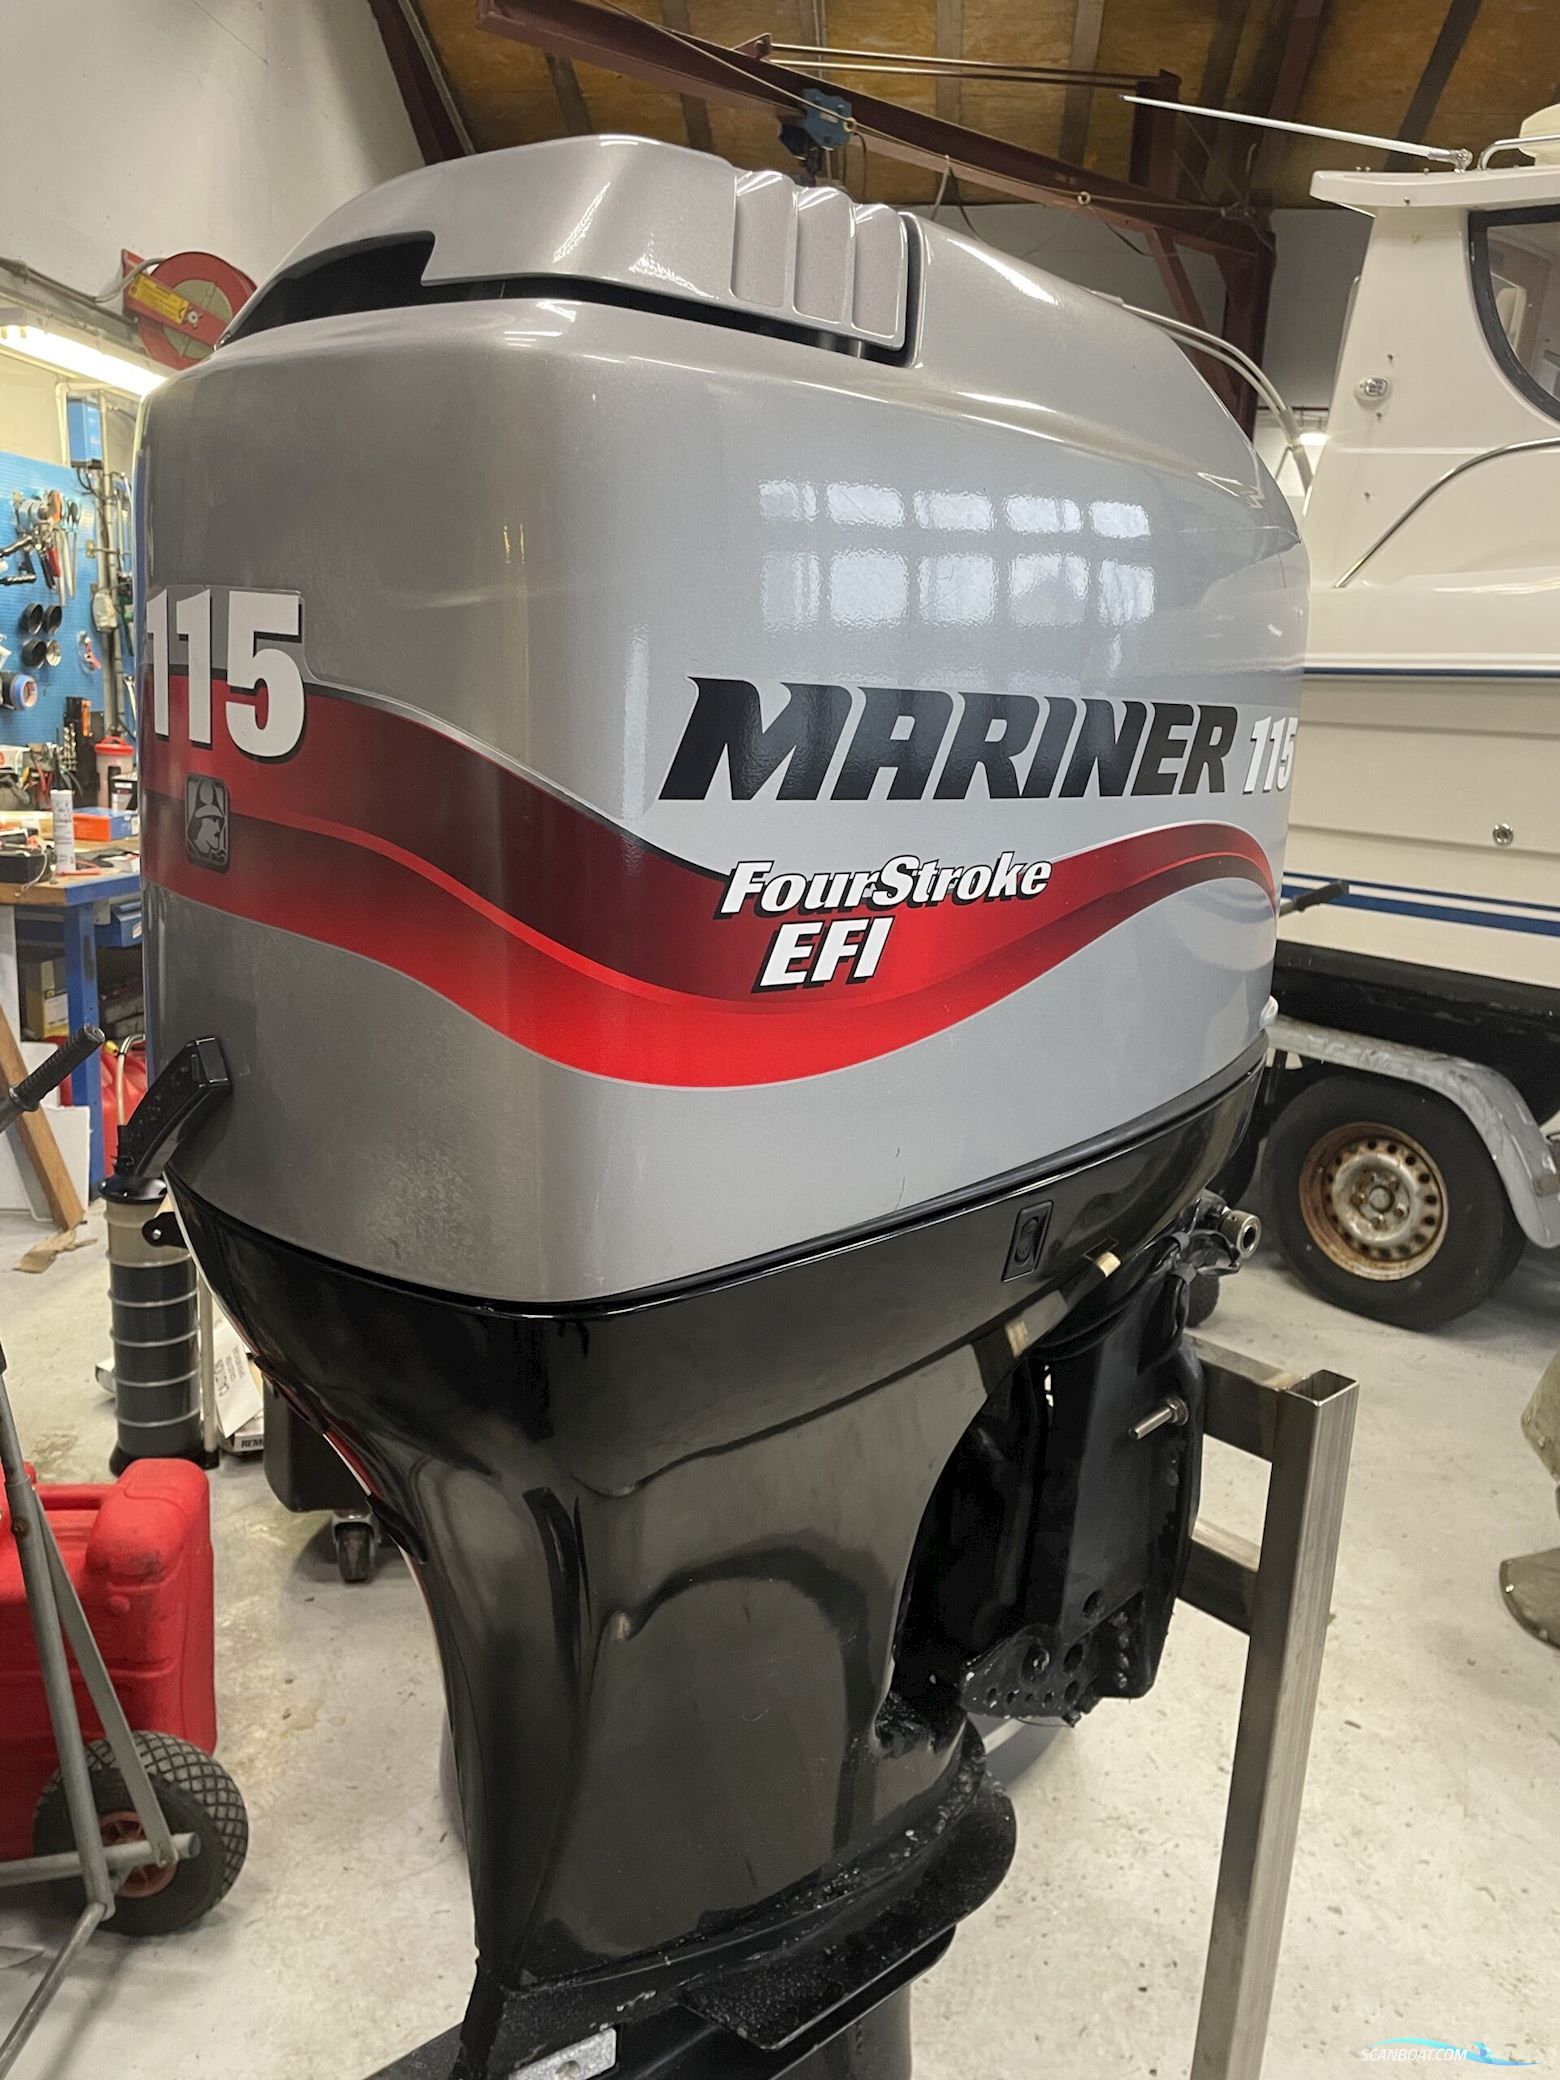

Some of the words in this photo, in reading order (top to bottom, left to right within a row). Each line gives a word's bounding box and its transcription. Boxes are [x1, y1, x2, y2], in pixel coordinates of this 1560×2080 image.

[146, 588, 306, 764] 115
[658, 676, 1238, 801] MARINER
[1243, 715, 1299, 795] 115
[714, 851, 1052, 919] FourStroke
[752, 915, 895, 993] EFI
